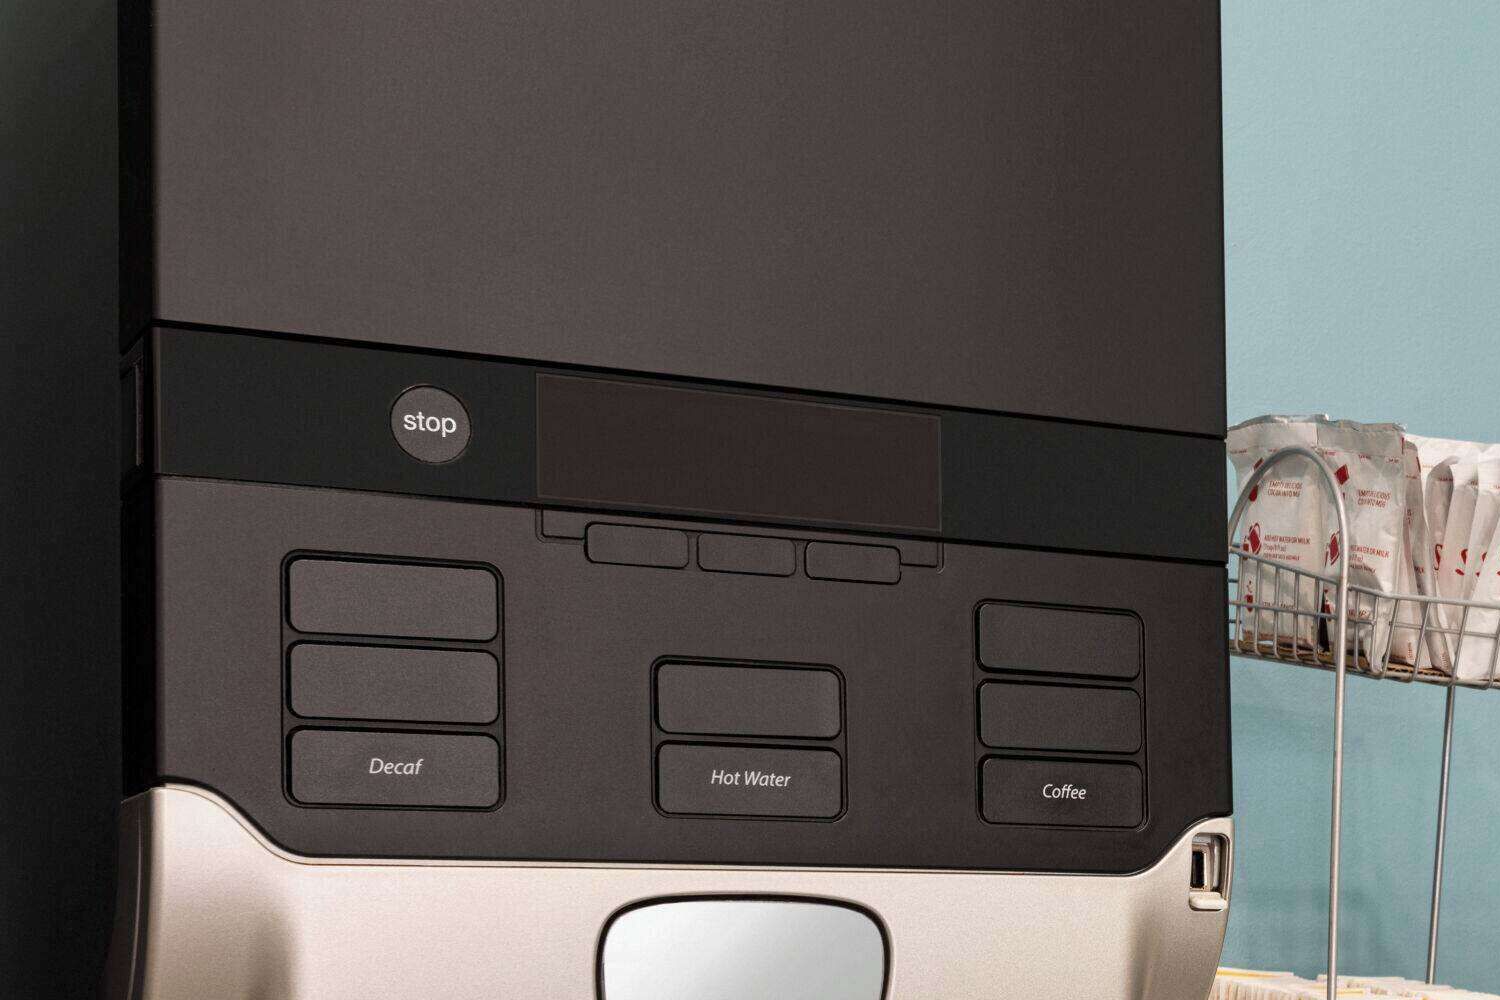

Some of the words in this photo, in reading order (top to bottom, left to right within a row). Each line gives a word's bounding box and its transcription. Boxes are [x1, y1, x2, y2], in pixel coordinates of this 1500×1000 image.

[404, 411, 458, 438] stop
[368, 757, 424, 776] Decaf
[710, 769, 741, 786] Hot
[743, 770, 792, 788] Water
[1042, 783, 1087, 801] Coffee
